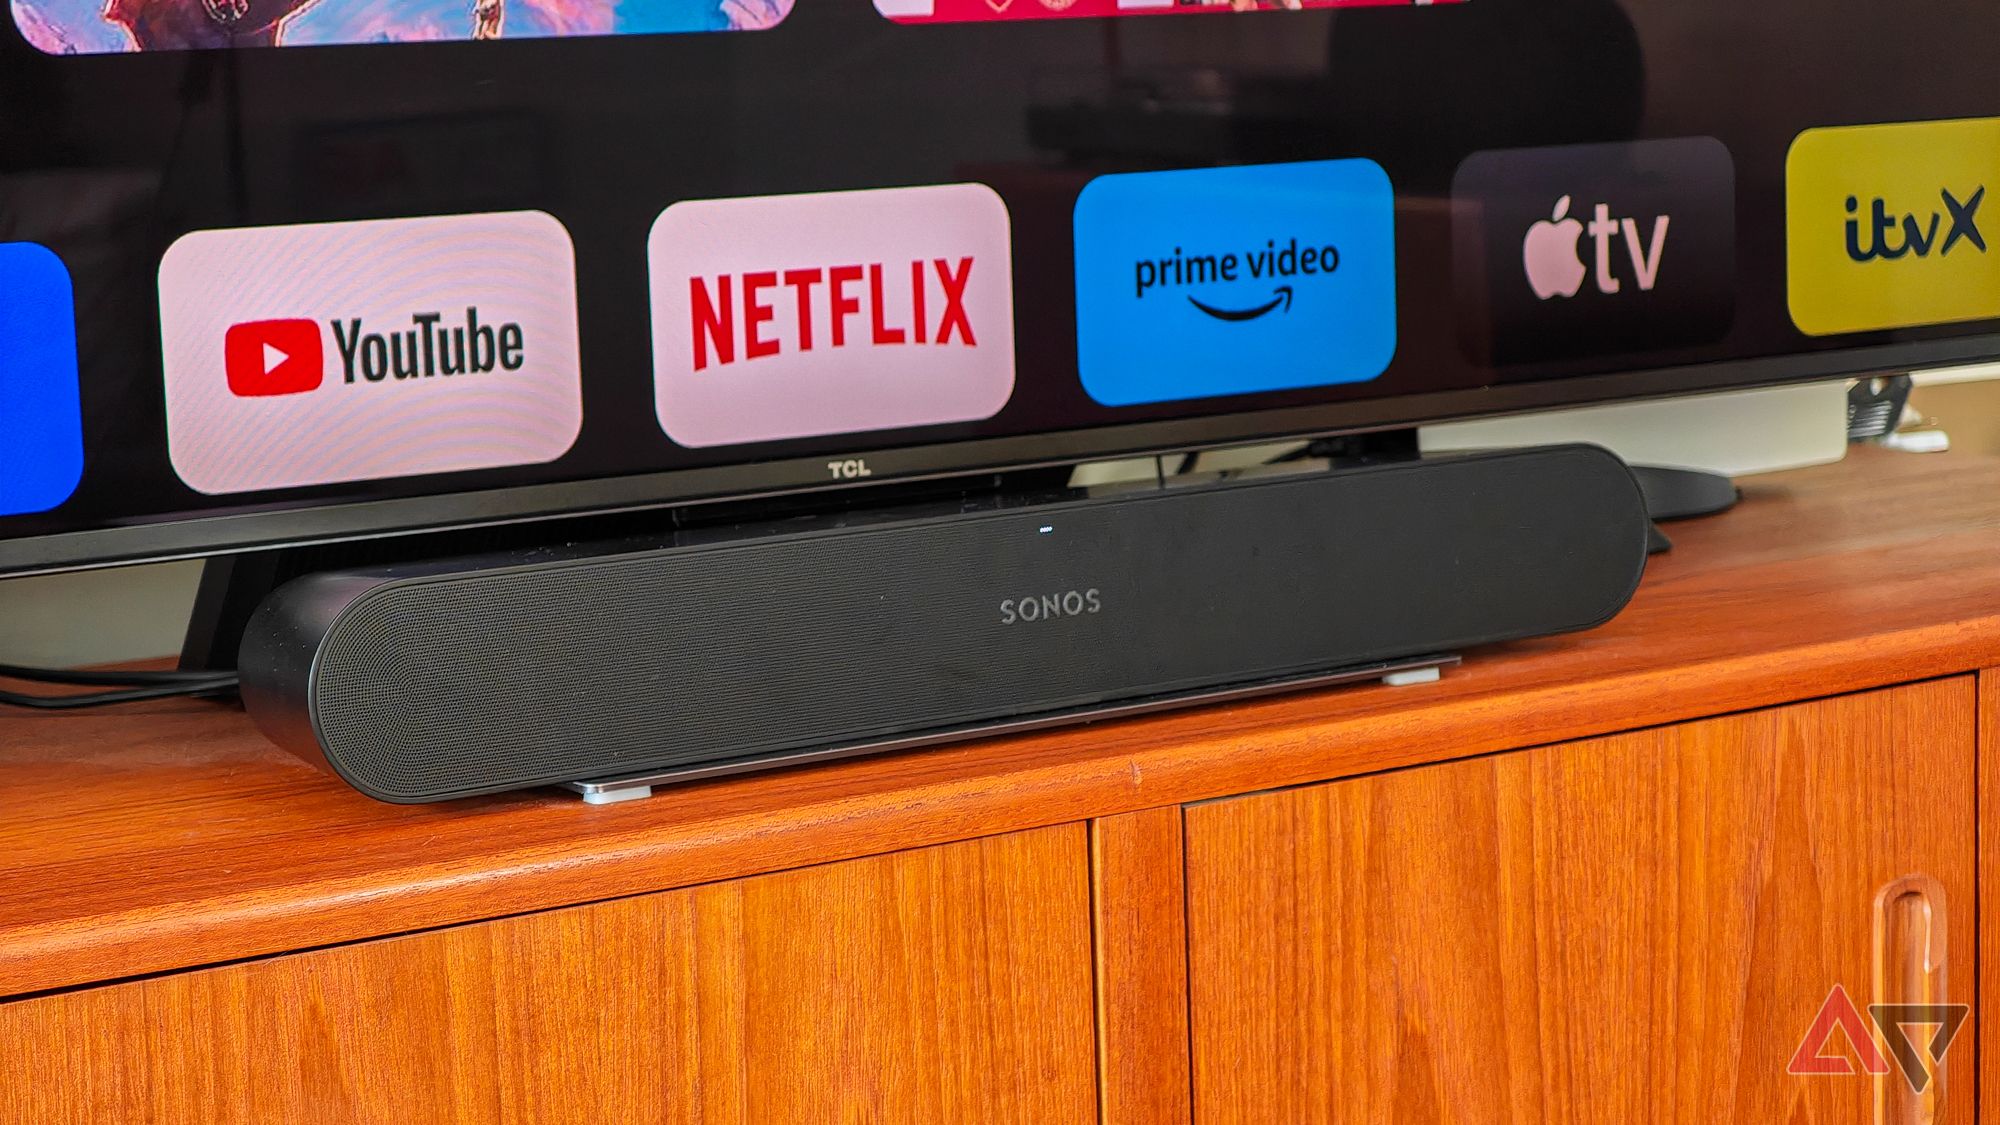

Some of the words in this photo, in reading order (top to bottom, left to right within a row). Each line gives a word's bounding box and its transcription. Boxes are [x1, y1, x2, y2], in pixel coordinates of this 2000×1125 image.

[1588, 203, 1670, 294] tv
[1845, 184, 1987, 263] itvX
[1135, 246, 1239, 298] prime
[1246, 236, 1340, 279] video
[330, 306, 525, 385] YouTube
[690, 256, 978, 372] NETFLIX
[827, 459, 872, 479] TCL
[1000, 588, 1100, 625] SONOS
